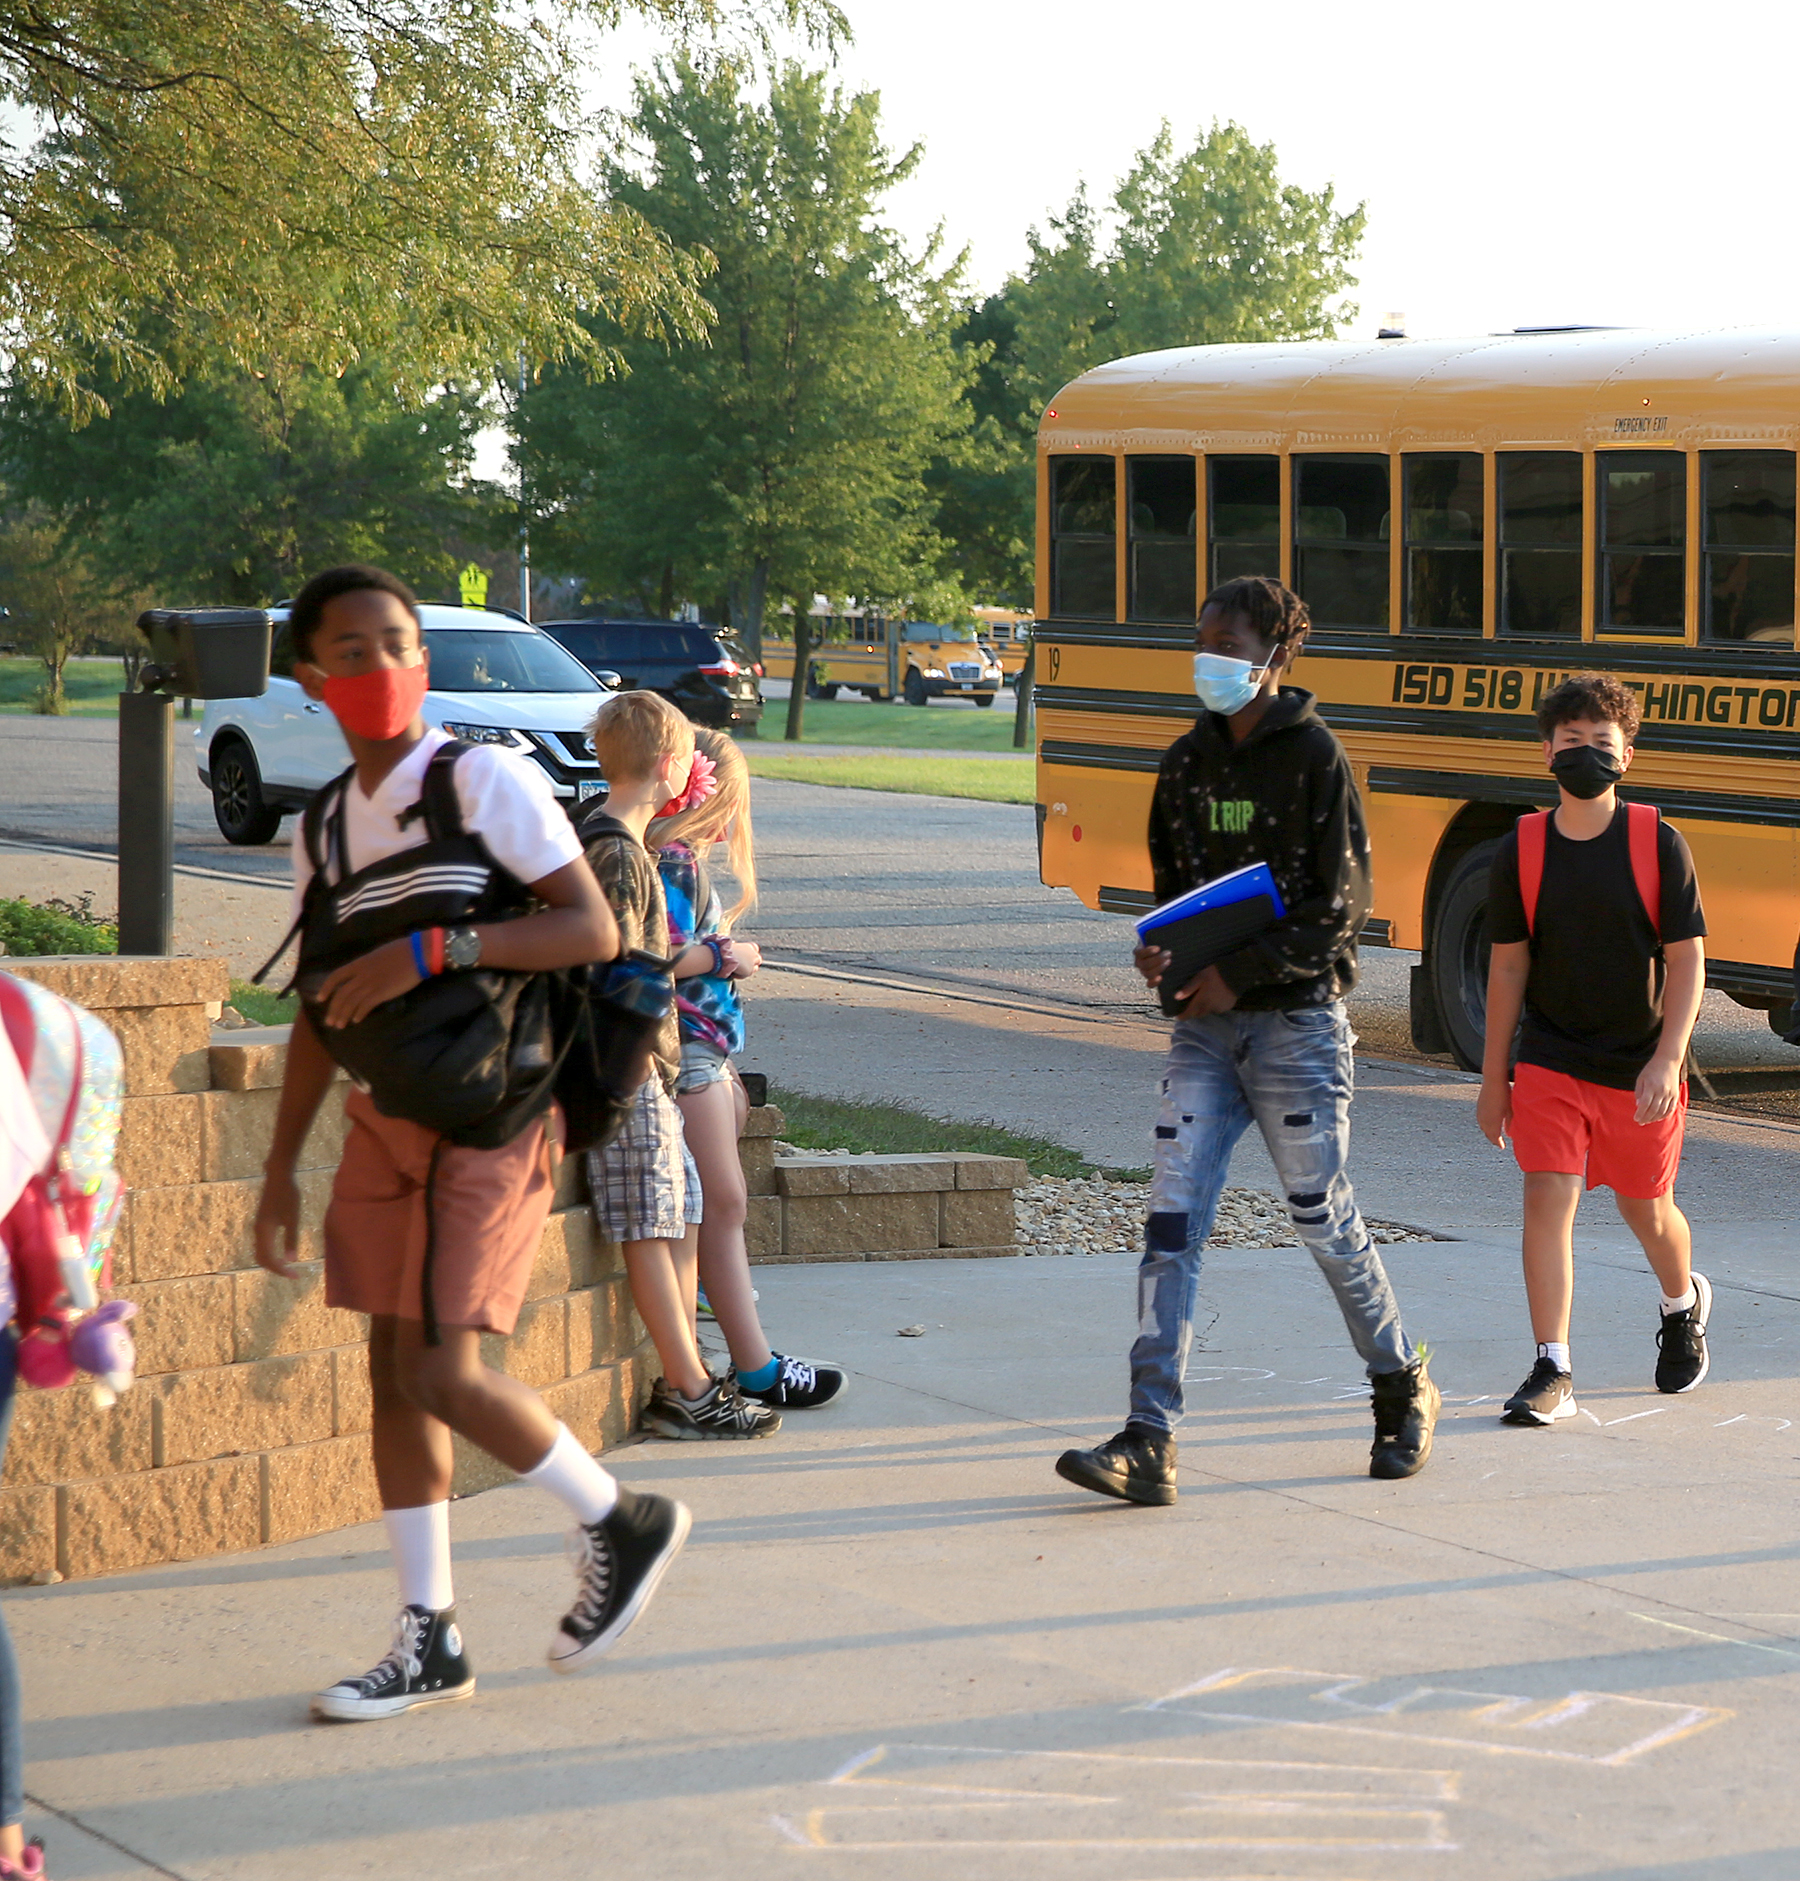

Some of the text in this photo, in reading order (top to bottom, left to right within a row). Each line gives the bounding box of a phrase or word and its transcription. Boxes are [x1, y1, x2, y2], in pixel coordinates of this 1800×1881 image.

[1614, 416, 1668, 433] EMERGENCY EXIT
[1048, 647, 1060, 682] 19
[1391, 663, 1454, 705] ISD
[1462, 667, 1524, 710] 518
